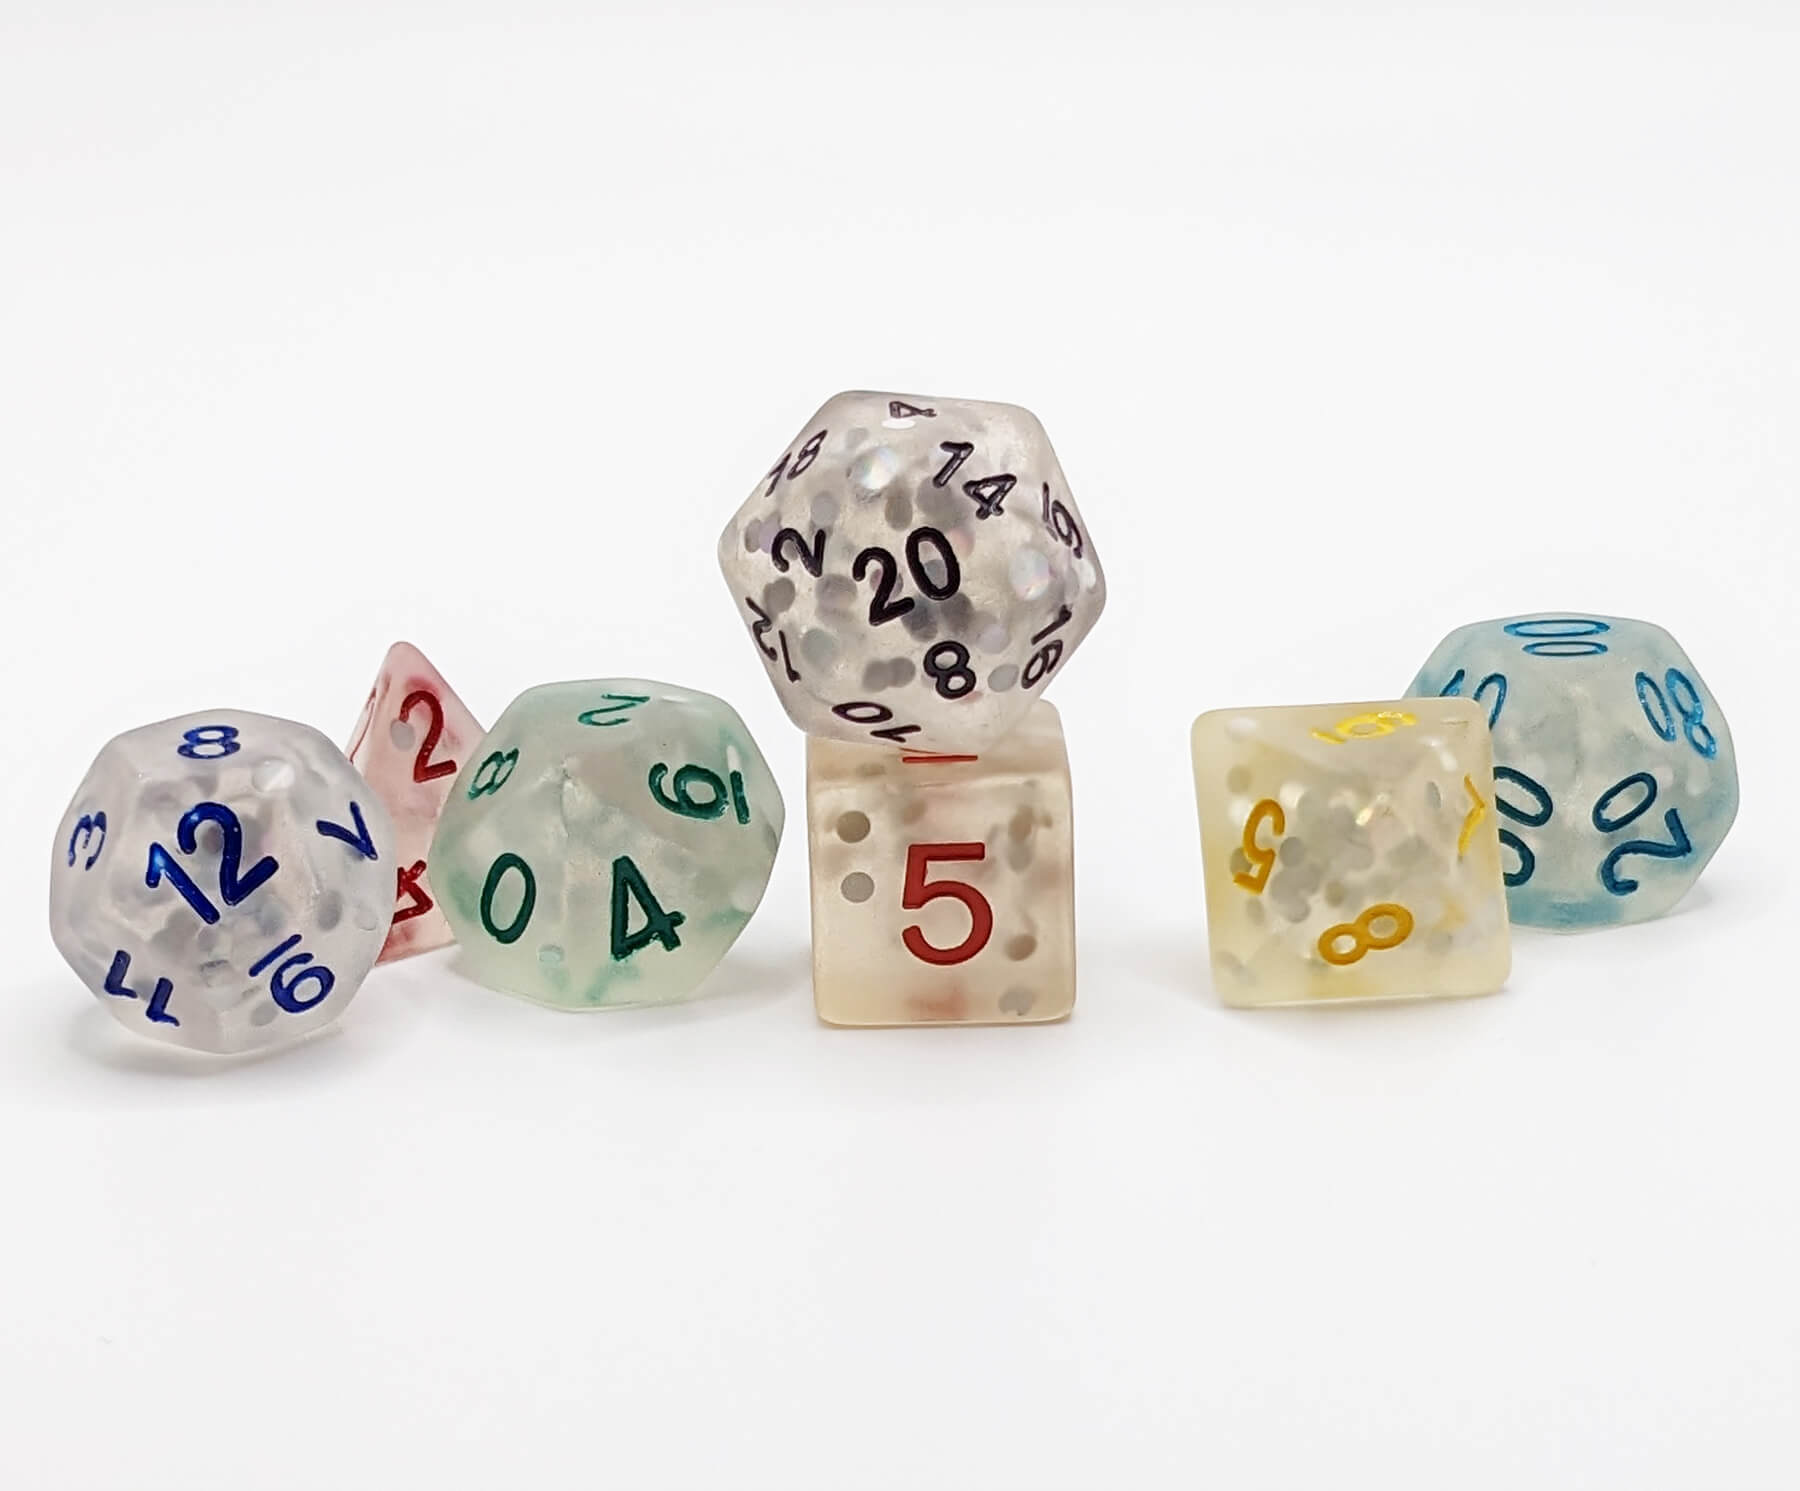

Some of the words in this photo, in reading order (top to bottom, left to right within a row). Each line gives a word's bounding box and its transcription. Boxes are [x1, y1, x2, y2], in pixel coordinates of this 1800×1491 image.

[889, 400, 937, 420] 4
[765, 429, 828, 497] 18
[933, 440, 1017, 520] 14
[771, 527, 826, 578] 2
[852, 526, 961, 626] 20
[745, 596, 801, 683] 12
[923, 640, 977, 700] 8
[1021, 604, 1073, 689] 16
[177, 725, 241, 760] 8
[401, 690, 458, 784] 2
[578, 693, 651, 727] 2
[831, 701, 922, 743] 10
[1634, 668, 1717, 760] 80
[468, 748, 519, 800] 8
[68, 811, 107, 871] 3
[145, 801, 279, 925] 12
[1233, 798, 1286, 894] 5
[1593, 772, 1692, 896] 20
[480, 852, 536, 945] 0
[611, 855, 687, 961] 4
[902, 842, 993, 966] 5
[1317, 903, 1414, 966] 8
